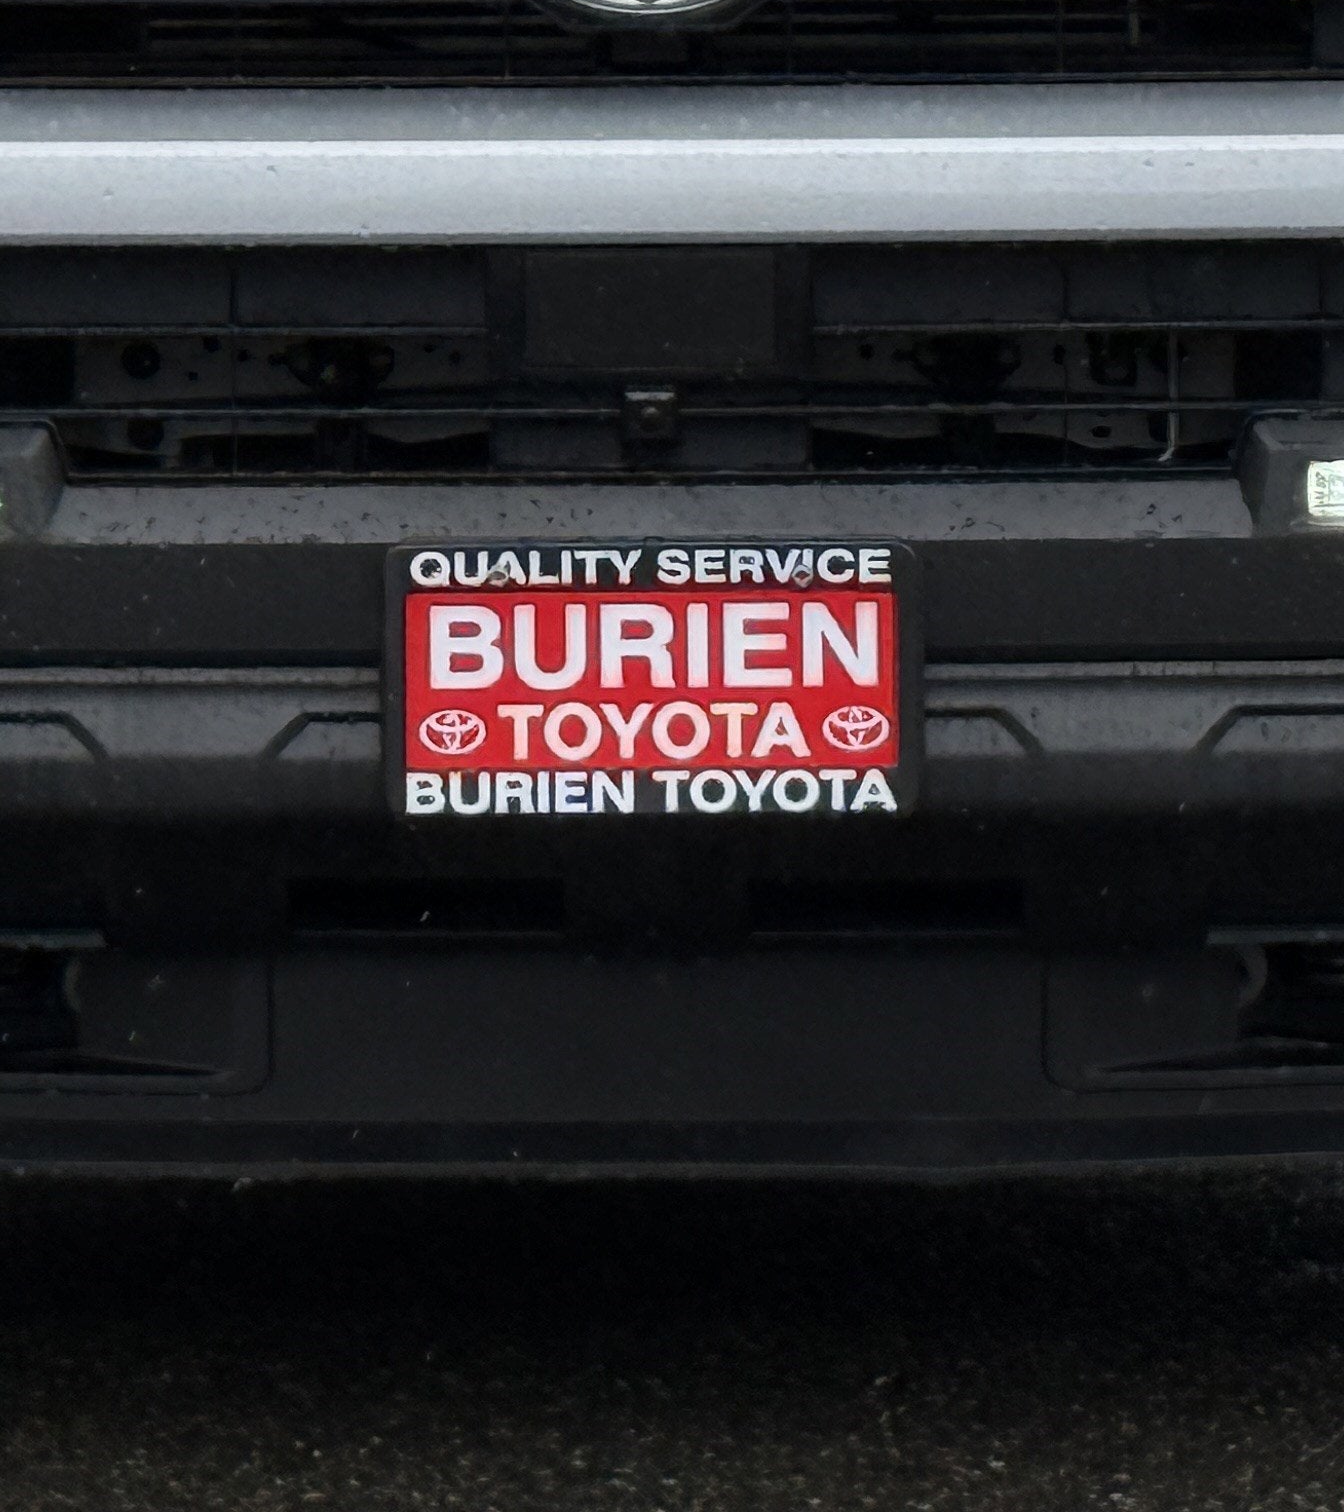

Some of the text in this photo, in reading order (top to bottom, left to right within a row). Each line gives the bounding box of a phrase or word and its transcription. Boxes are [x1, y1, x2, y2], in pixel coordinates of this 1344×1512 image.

[409, 548, 893, 586] QUALITY SERVICE
[428, 600, 881, 691] BURIEN
[497, 701, 812, 761] TOYOTA
[405, 769, 898, 814] BURIEN TOYOTA
